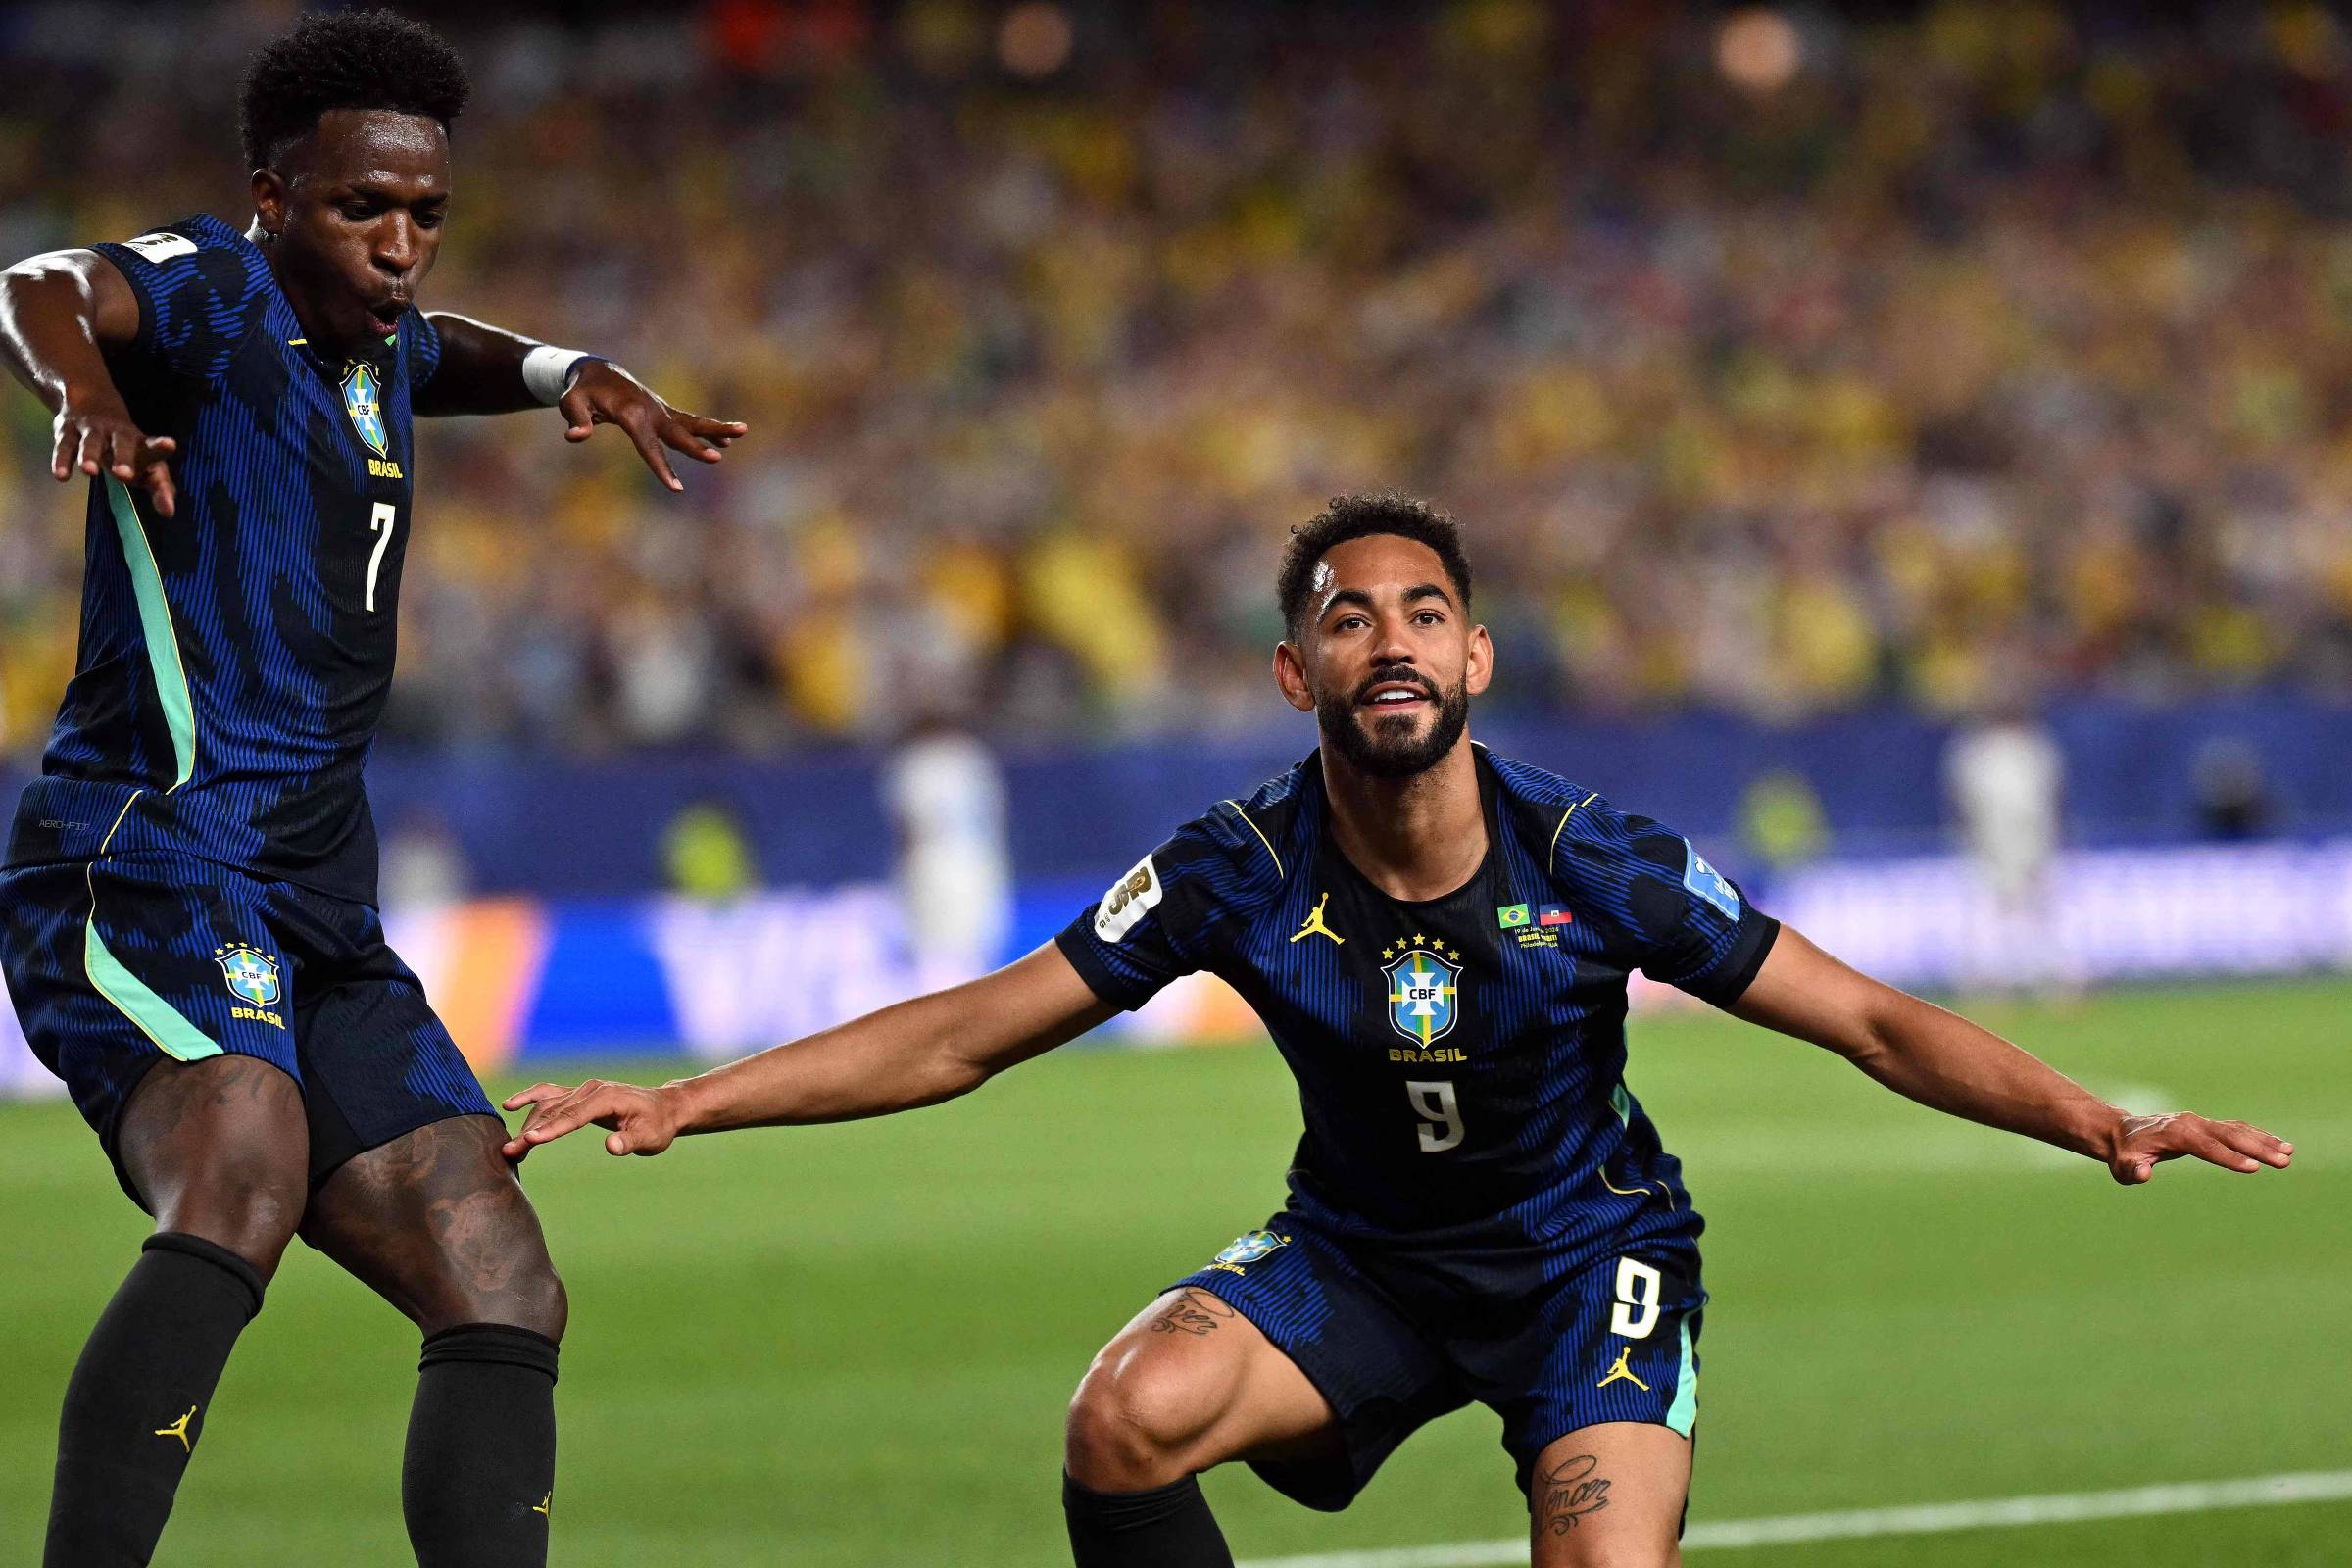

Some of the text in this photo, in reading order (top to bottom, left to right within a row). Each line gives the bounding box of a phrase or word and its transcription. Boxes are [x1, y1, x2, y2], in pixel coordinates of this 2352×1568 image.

[357, 404, 370, 416] CBF
[368, 458, 404, 479] BRASIL
[366, 501, 396, 612] 7
[241, 971, 262, 980] CBF
[1409, 988, 1437, 1000] CBF
[231, 1006, 286, 1030] BRASIL
[1389, 1048, 1468, 1063] BRASIL
[1405, 1080, 1465, 1152] 9
[1610, 1255, 1661, 1340] 9
